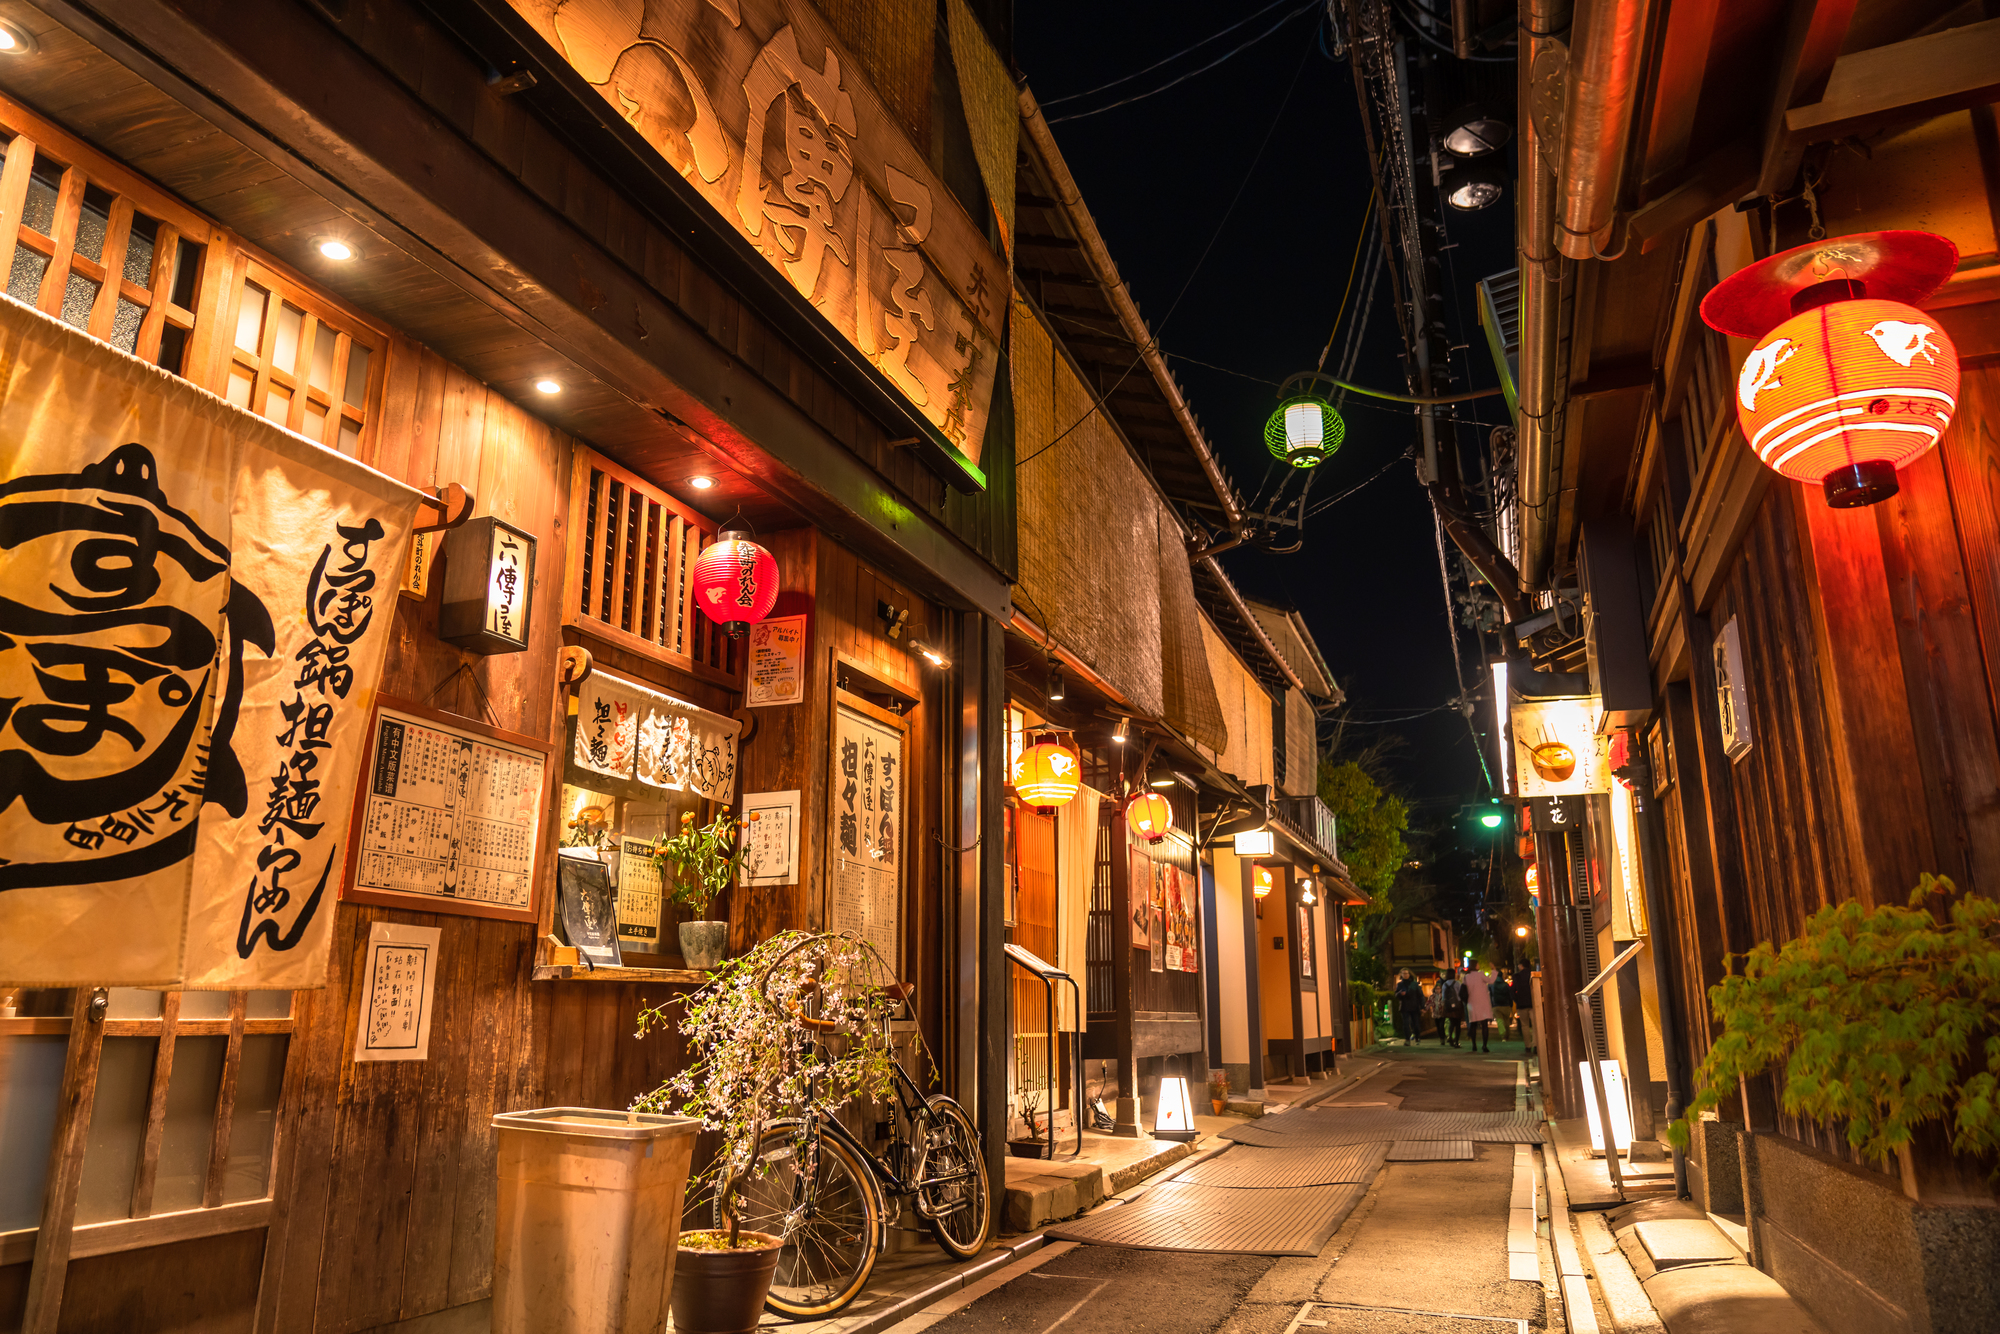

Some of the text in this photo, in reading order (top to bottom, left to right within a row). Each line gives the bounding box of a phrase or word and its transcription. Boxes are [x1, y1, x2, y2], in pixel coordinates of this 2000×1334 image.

[494, 536, 521, 637] 六傳屋
[588, 696, 612, 769] 担々麺
[839, 736, 859, 857] 担々麺
[878, 751, 897, 866] すっぽん鍋
[627, 844, 651, 856] お持ち帰
